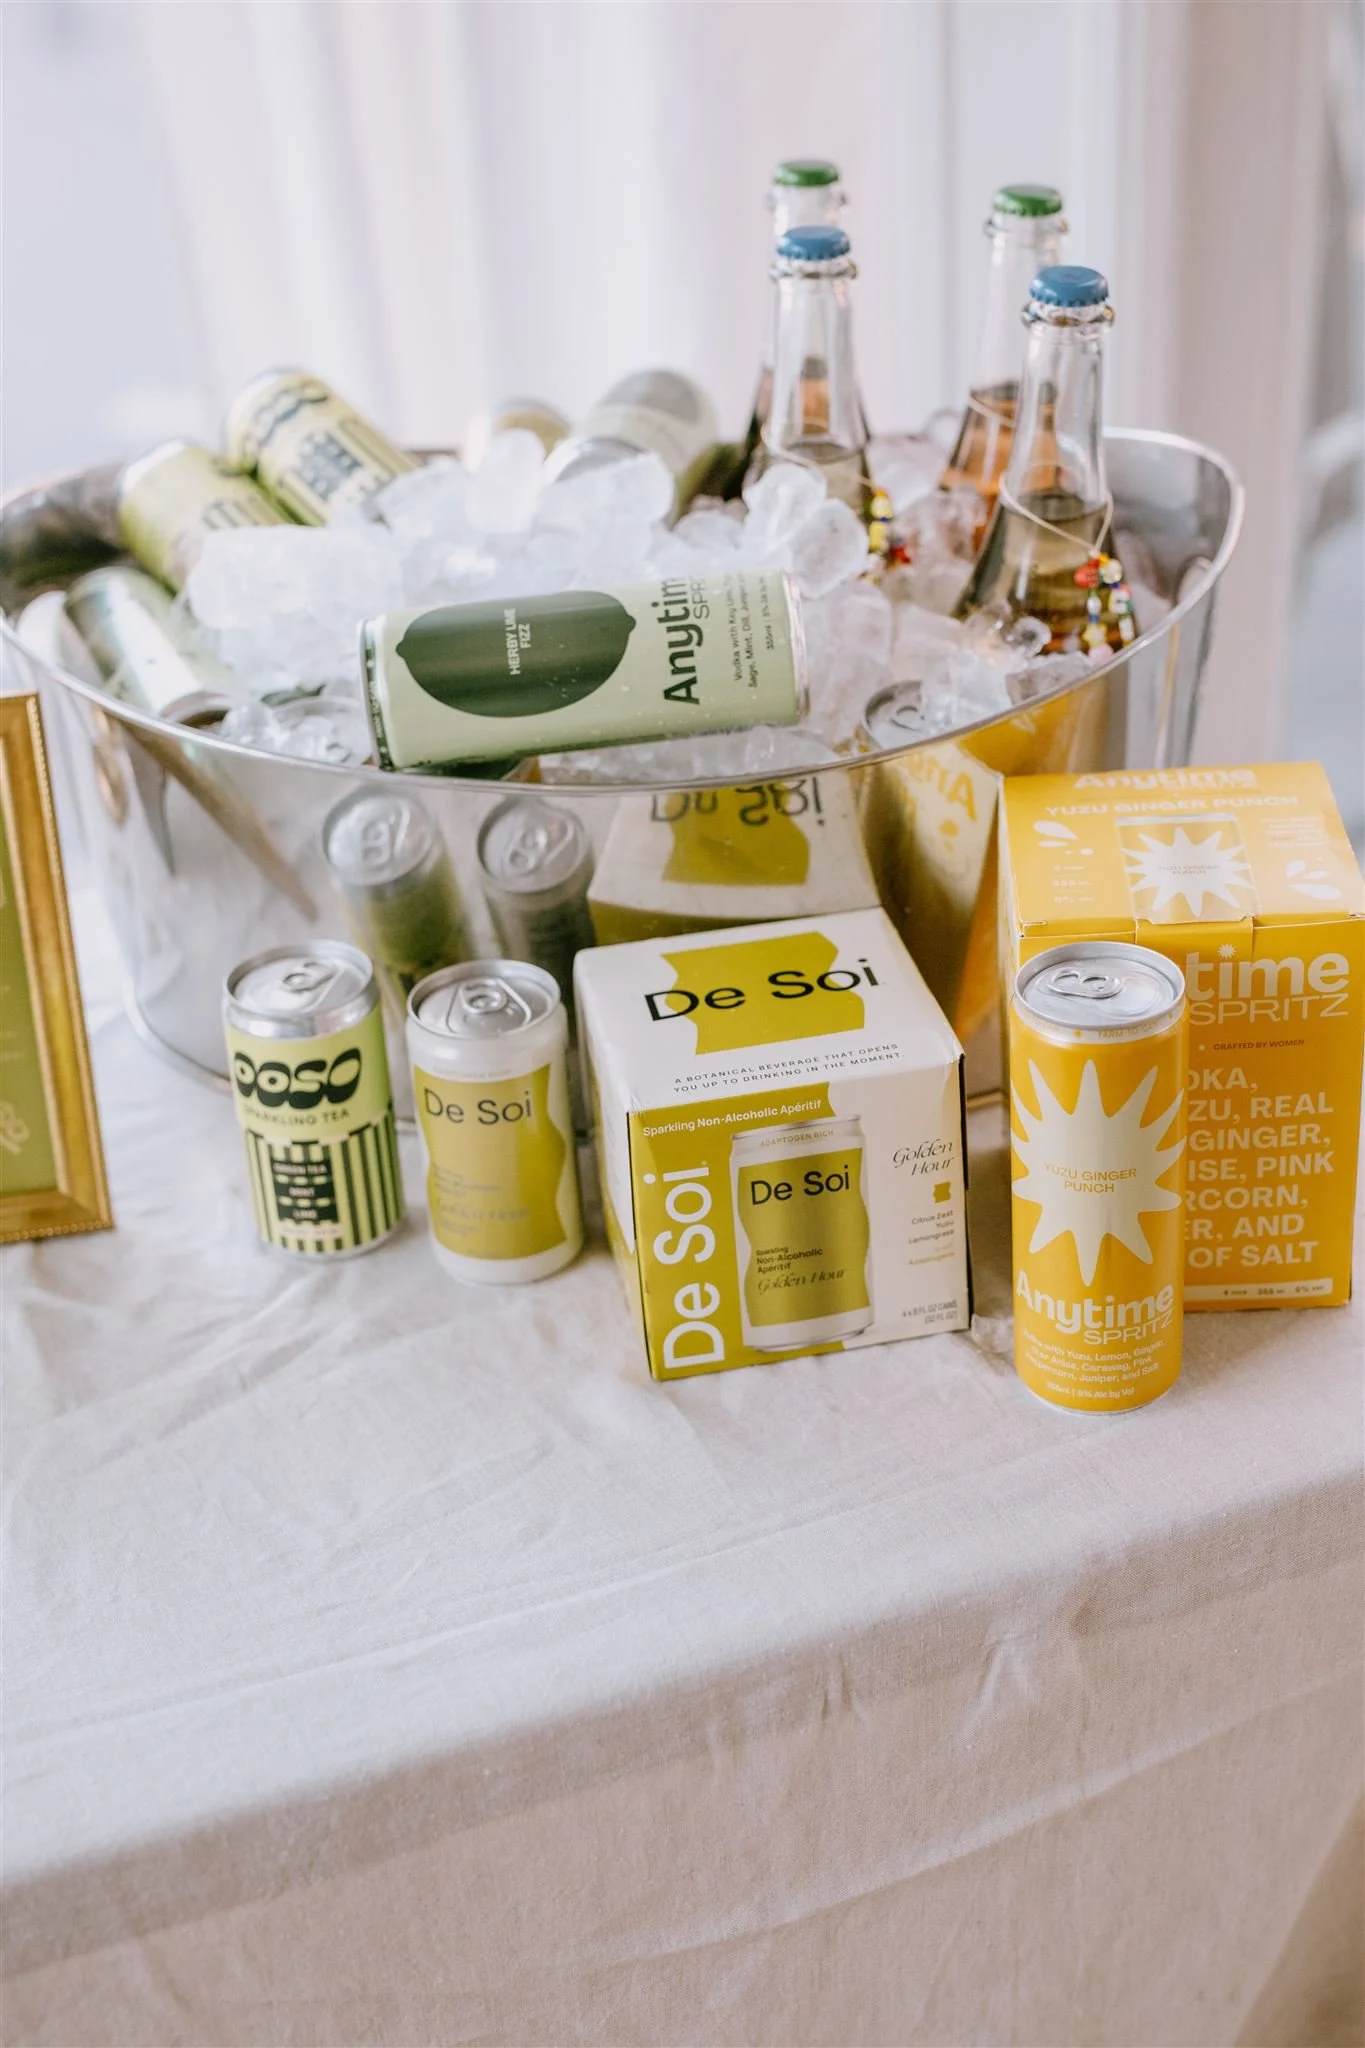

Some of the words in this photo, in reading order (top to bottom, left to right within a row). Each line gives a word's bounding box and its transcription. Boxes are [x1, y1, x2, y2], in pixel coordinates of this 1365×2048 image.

[504, 608, 517, 632] LIME
[519, 623, 531, 649] FIZZ
[651, 577, 704, 705] Anytim
[505, 634, 521, 675] HERBY
[1044, 804, 1108, 816] YUZU
[1114, 800, 1208, 813] GINGER
[1214, 795, 1299, 808] PUNCH
[1185, 943, 1350, 1001] time
[644, 987, 746, 1021] De
[767, 957, 879, 998] Soi
[1190, 993, 1349, 1027] SPRITZ
[1213, 1042, 1254, 1051] CRAFTED
[1256, 1041, 1267, 1050] BY
[1269, 1038, 1305, 1048] WOMEN
[673, 1084, 697, 1093] YOU
[743, 1068, 802, 1082] DRINKING
[823, 1062, 846, 1070] THE
[850, 1052, 905, 1065] MOMENT.
[686, 1067, 755, 1082] BOTANICAL
[758, 1056, 821, 1071] BEVERAGE
[824, 1050, 854, 1061] THAT
[858, 1043, 898, 1055] OPENS
[321, 1108, 350, 1123] TEA
[423, 1088, 465, 1124] De
[477, 1090, 532, 1126] Soi
[642, 1120, 696, 1137] Sparkling
[696, 1106, 779, 1128] Non-Alcoholic
[780, 1099, 822, 1118] Apéritif
[1188, 1098, 1240, 1124] ZU,
[1250, 1092, 1334, 1118] REAL
[760, 1131, 812, 1147] ADAPTOGEN
[814, 1129, 834, 1140] RICH
[1188, 1122, 1331, 1152] GINGER,
[893, 1138, 953, 1168] Golden
[911, 1157, 955, 1176] Hour
[1187, 1158, 1247, 1183] ISE,
[1256, 1150, 1335, 1178] PINK
[751, 1179, 793, 1205] De
[803, 1164, 850, 1197] Soi
[1044, 1162, 1077, 1179] YUZU
[1082, 1168, 1137, 1181] GINGER
[1064, 1181, 1115, 1193] PUNCH
[1185, 1182, 1309, 1212] RCORN,
[643, 1165, 716, 1266] Soi
[1231, 1213, 1305, 1239] AND
[756, 1248, 823, 1265] Non-Alcoholic
[1187, 1245, 1232, 1269] OF
[1240, 1241, 1319, 1267] SALT
[1015, 1268, 1175, 1334] Anytime
[663, 1281, 725, 1369] De
[1083, 1309, 1174, 1345] SPRITZ
[1051, 1357, 1080, 1370] Anise,
[1133, 1356, 1153, 1368] Pink
[1067, 1350, 1093, 1362] Yuzu,
[1095, 1352, 1131, 1362] Lemon,
[1080, 1373, 1119, 1385] Juniper,
[1122, 1368, 1140, 1381] and
